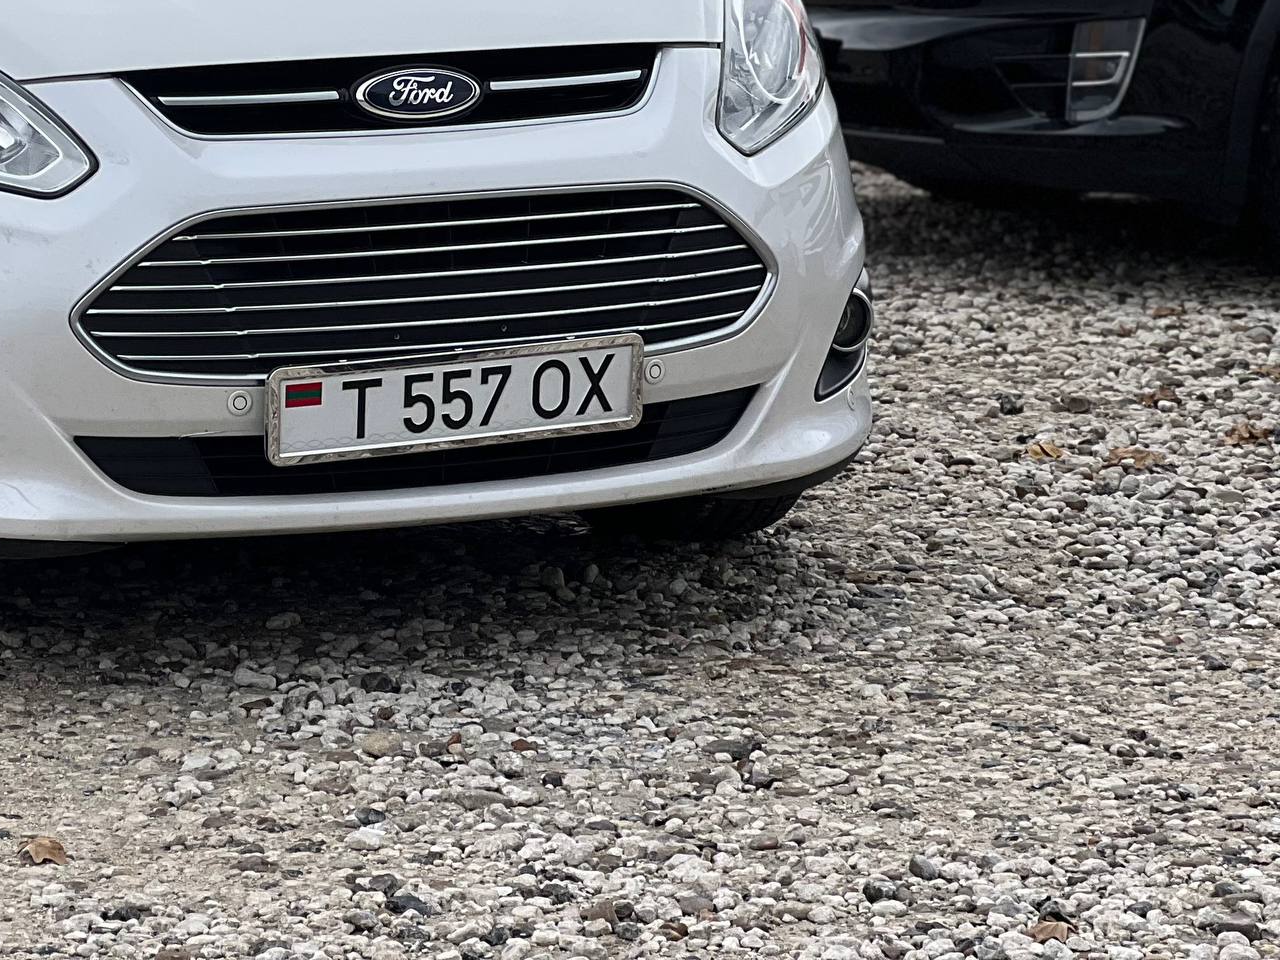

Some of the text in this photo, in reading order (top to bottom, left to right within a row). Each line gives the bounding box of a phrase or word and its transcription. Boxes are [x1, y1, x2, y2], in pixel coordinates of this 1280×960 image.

[388, 75, 454, 107] Ford
[342, 353, 616, 439] T 557 OX
